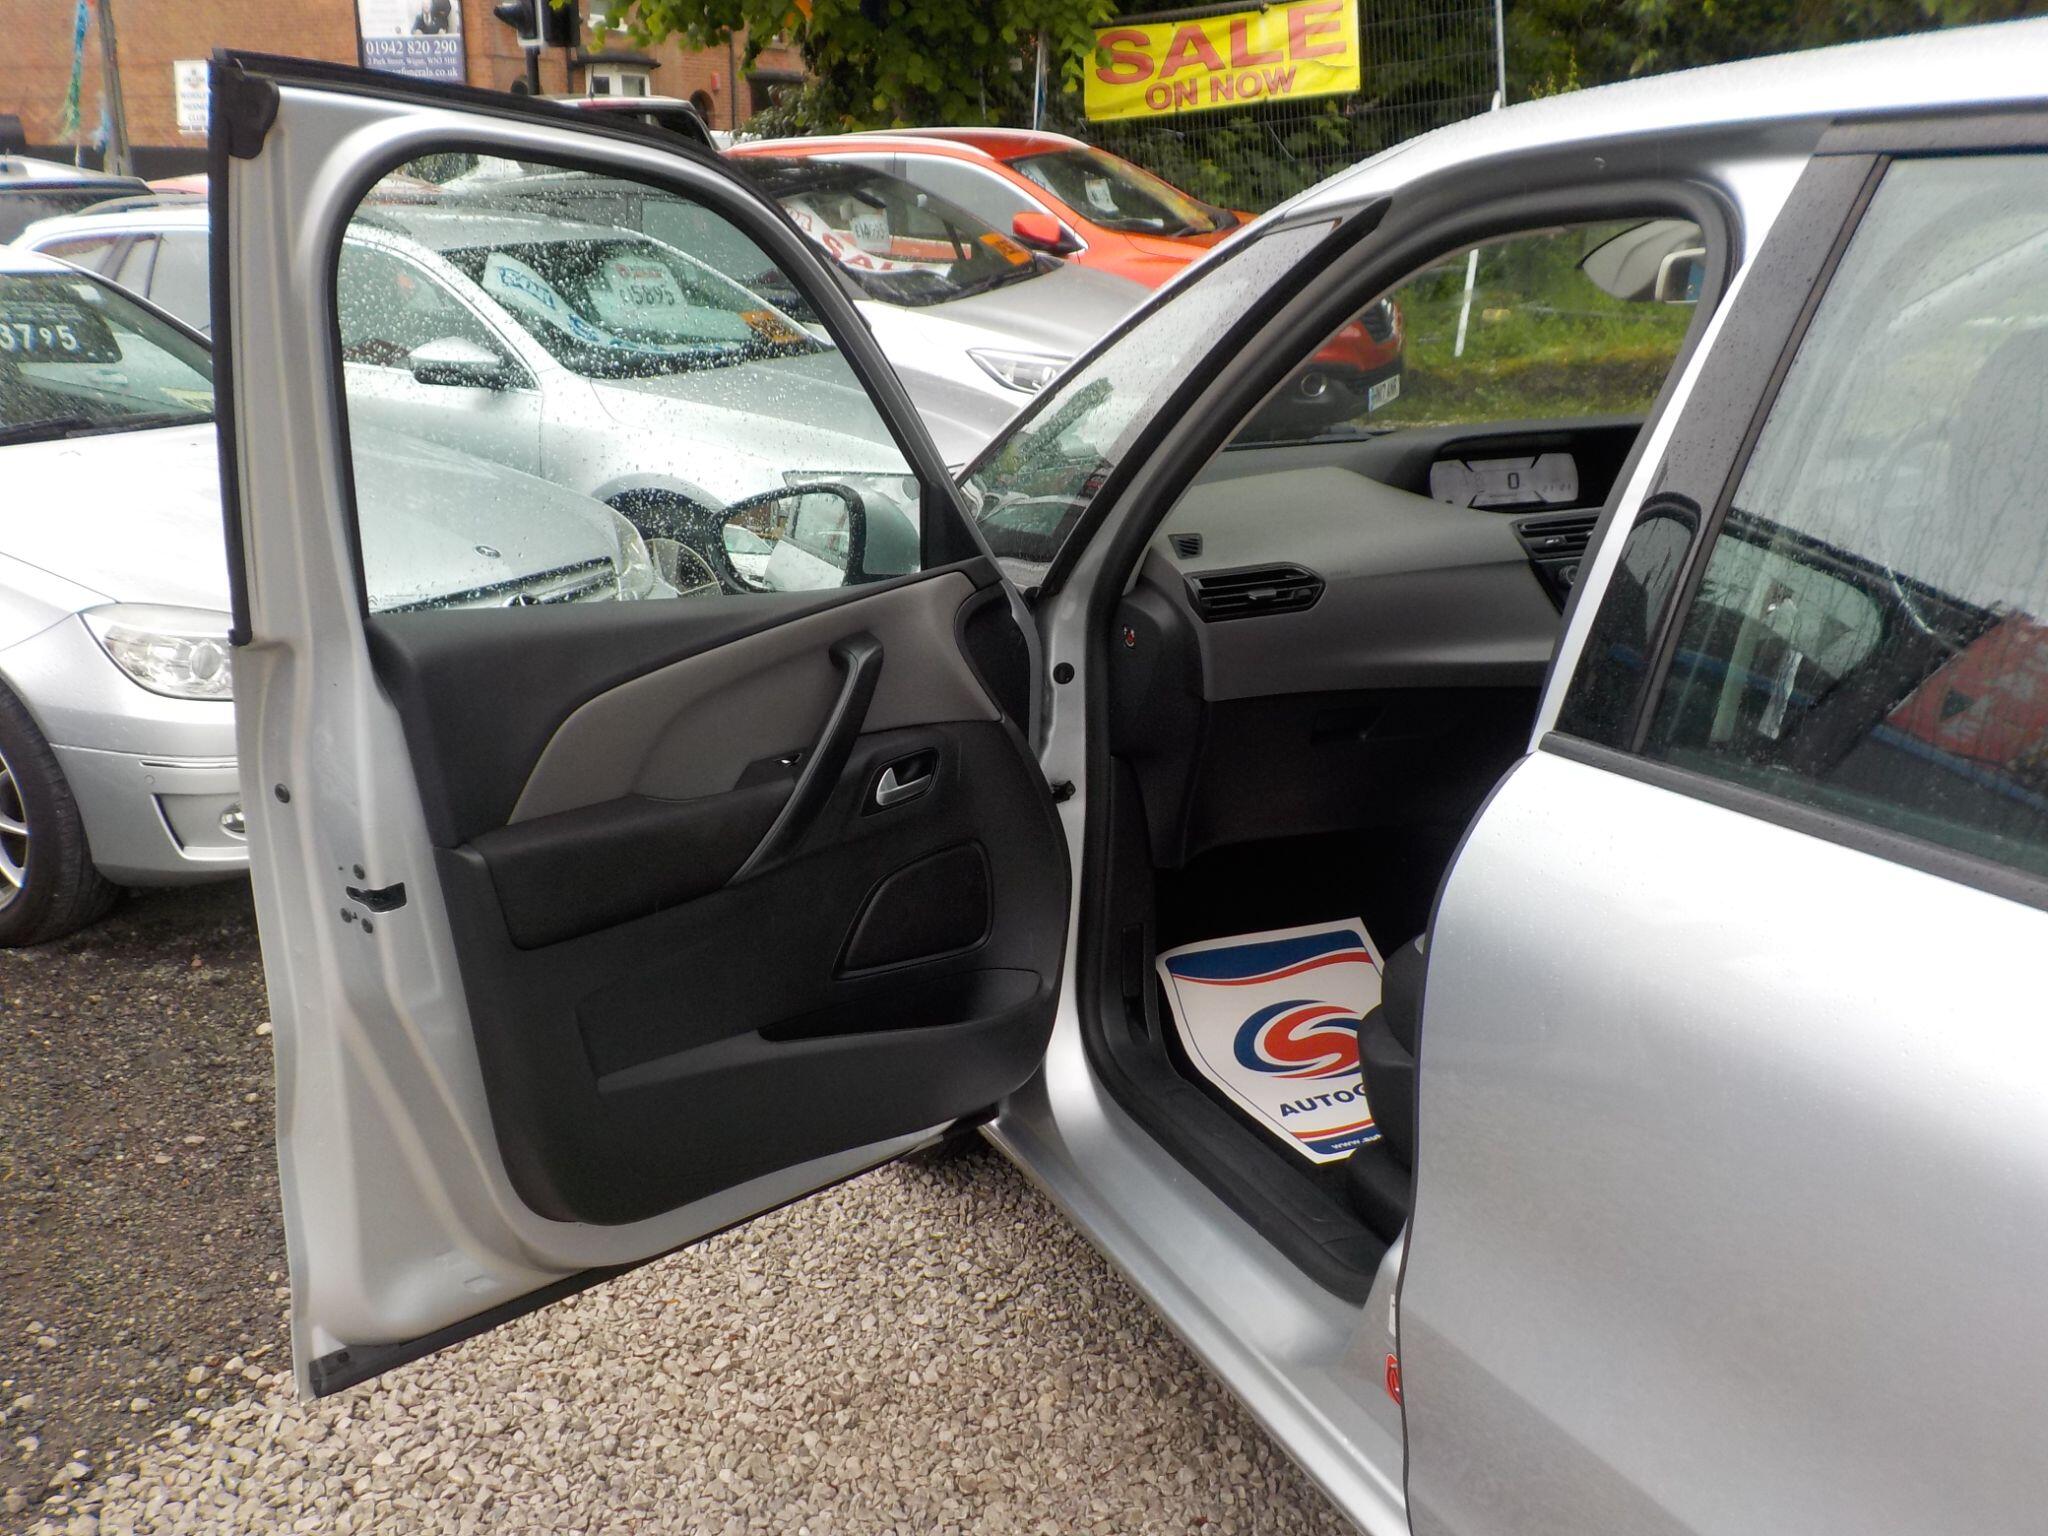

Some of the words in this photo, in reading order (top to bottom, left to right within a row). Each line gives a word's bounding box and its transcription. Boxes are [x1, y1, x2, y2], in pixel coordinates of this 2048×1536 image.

[365, 40, 403, 55] 01942
[407, 40, 429, 54] 820
[434, 40, 456, 54] 290
[1096, 0, 1346, 85] SALE
[1145, 78, 1198, 110] ON
[1211, 66, 1296, 101] NOW
[1508, 472, 1520, 489] 0
